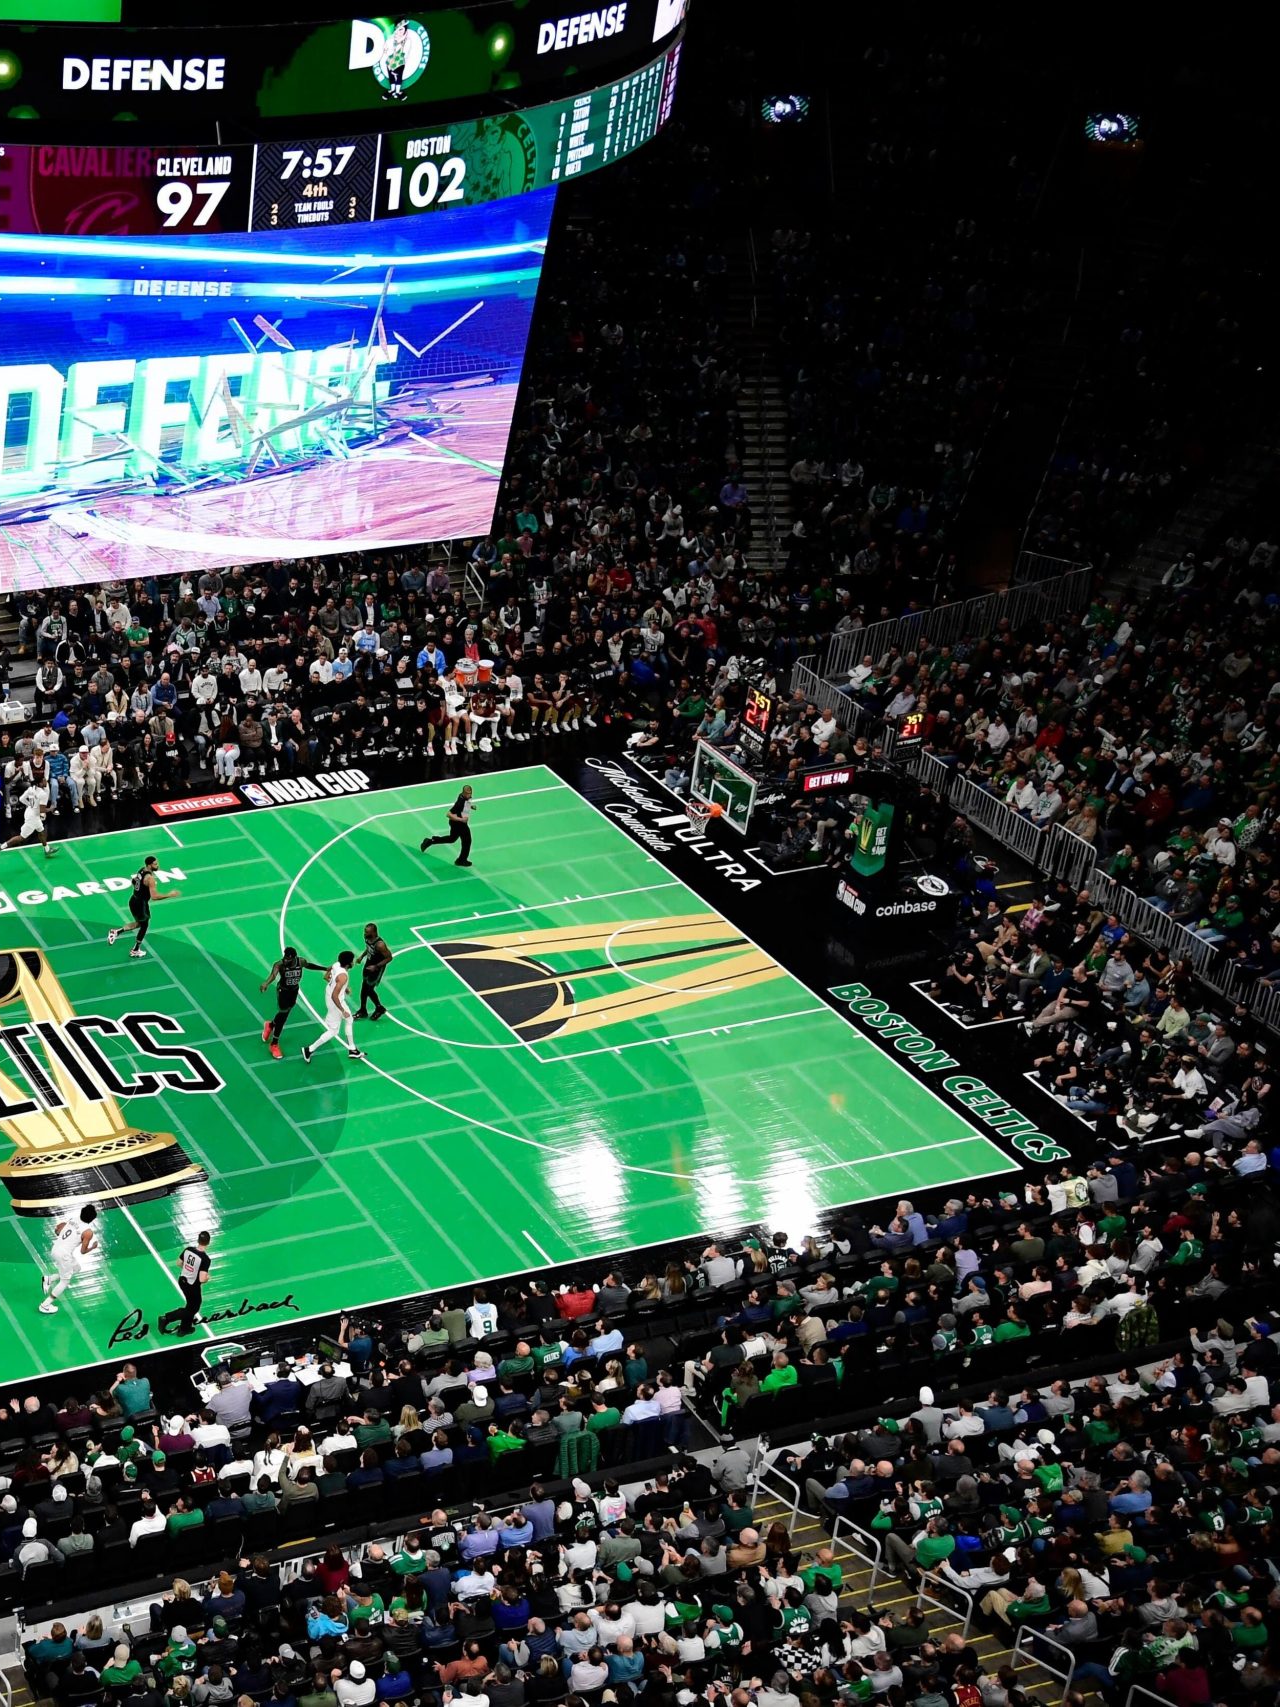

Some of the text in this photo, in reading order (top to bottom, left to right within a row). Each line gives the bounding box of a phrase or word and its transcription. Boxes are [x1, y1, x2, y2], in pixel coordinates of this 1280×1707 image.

[537, 4, 626, 55] DEFENSE
[62, 58, 225, 91] DEFENSE
[406, 135, 451, 159] BOSTON
[157, 157, 232, 177] CLEVELAND
[280, 146, 356, 180] 7:57
[303, 182, 328, 197] 4th
[386, 157, 466, 211] 102
[157, 182, 231, 227] 97
[294, 202, 312, 212] TEAM
[313, 200, 334, 211] FOULS
[133, 279, 232, 297] DEFENSE
[262, 768, 370, 803] NBA CUP
[585, 758, 674, 813] Michelob
[809, 772, 849, 788] GET THE App
[157, 793, 237, 815] Emirates
[605, 803, 677, 852] Courtside
[876, 827, 887, 837] GET
[875, 837, 886, 846] THE
[675, 828, 762, 892] ULTRA
[17, 867, 188, 905] GARDN
[854, 898, 866, 916] CUP
[876, 901, 936, 917] coinbase
[827, 982, 1071, 1163] BOSTON CELTICS
[187, 1254, 195, 1266] 50
[483, 1320, 491, 1333] 9
